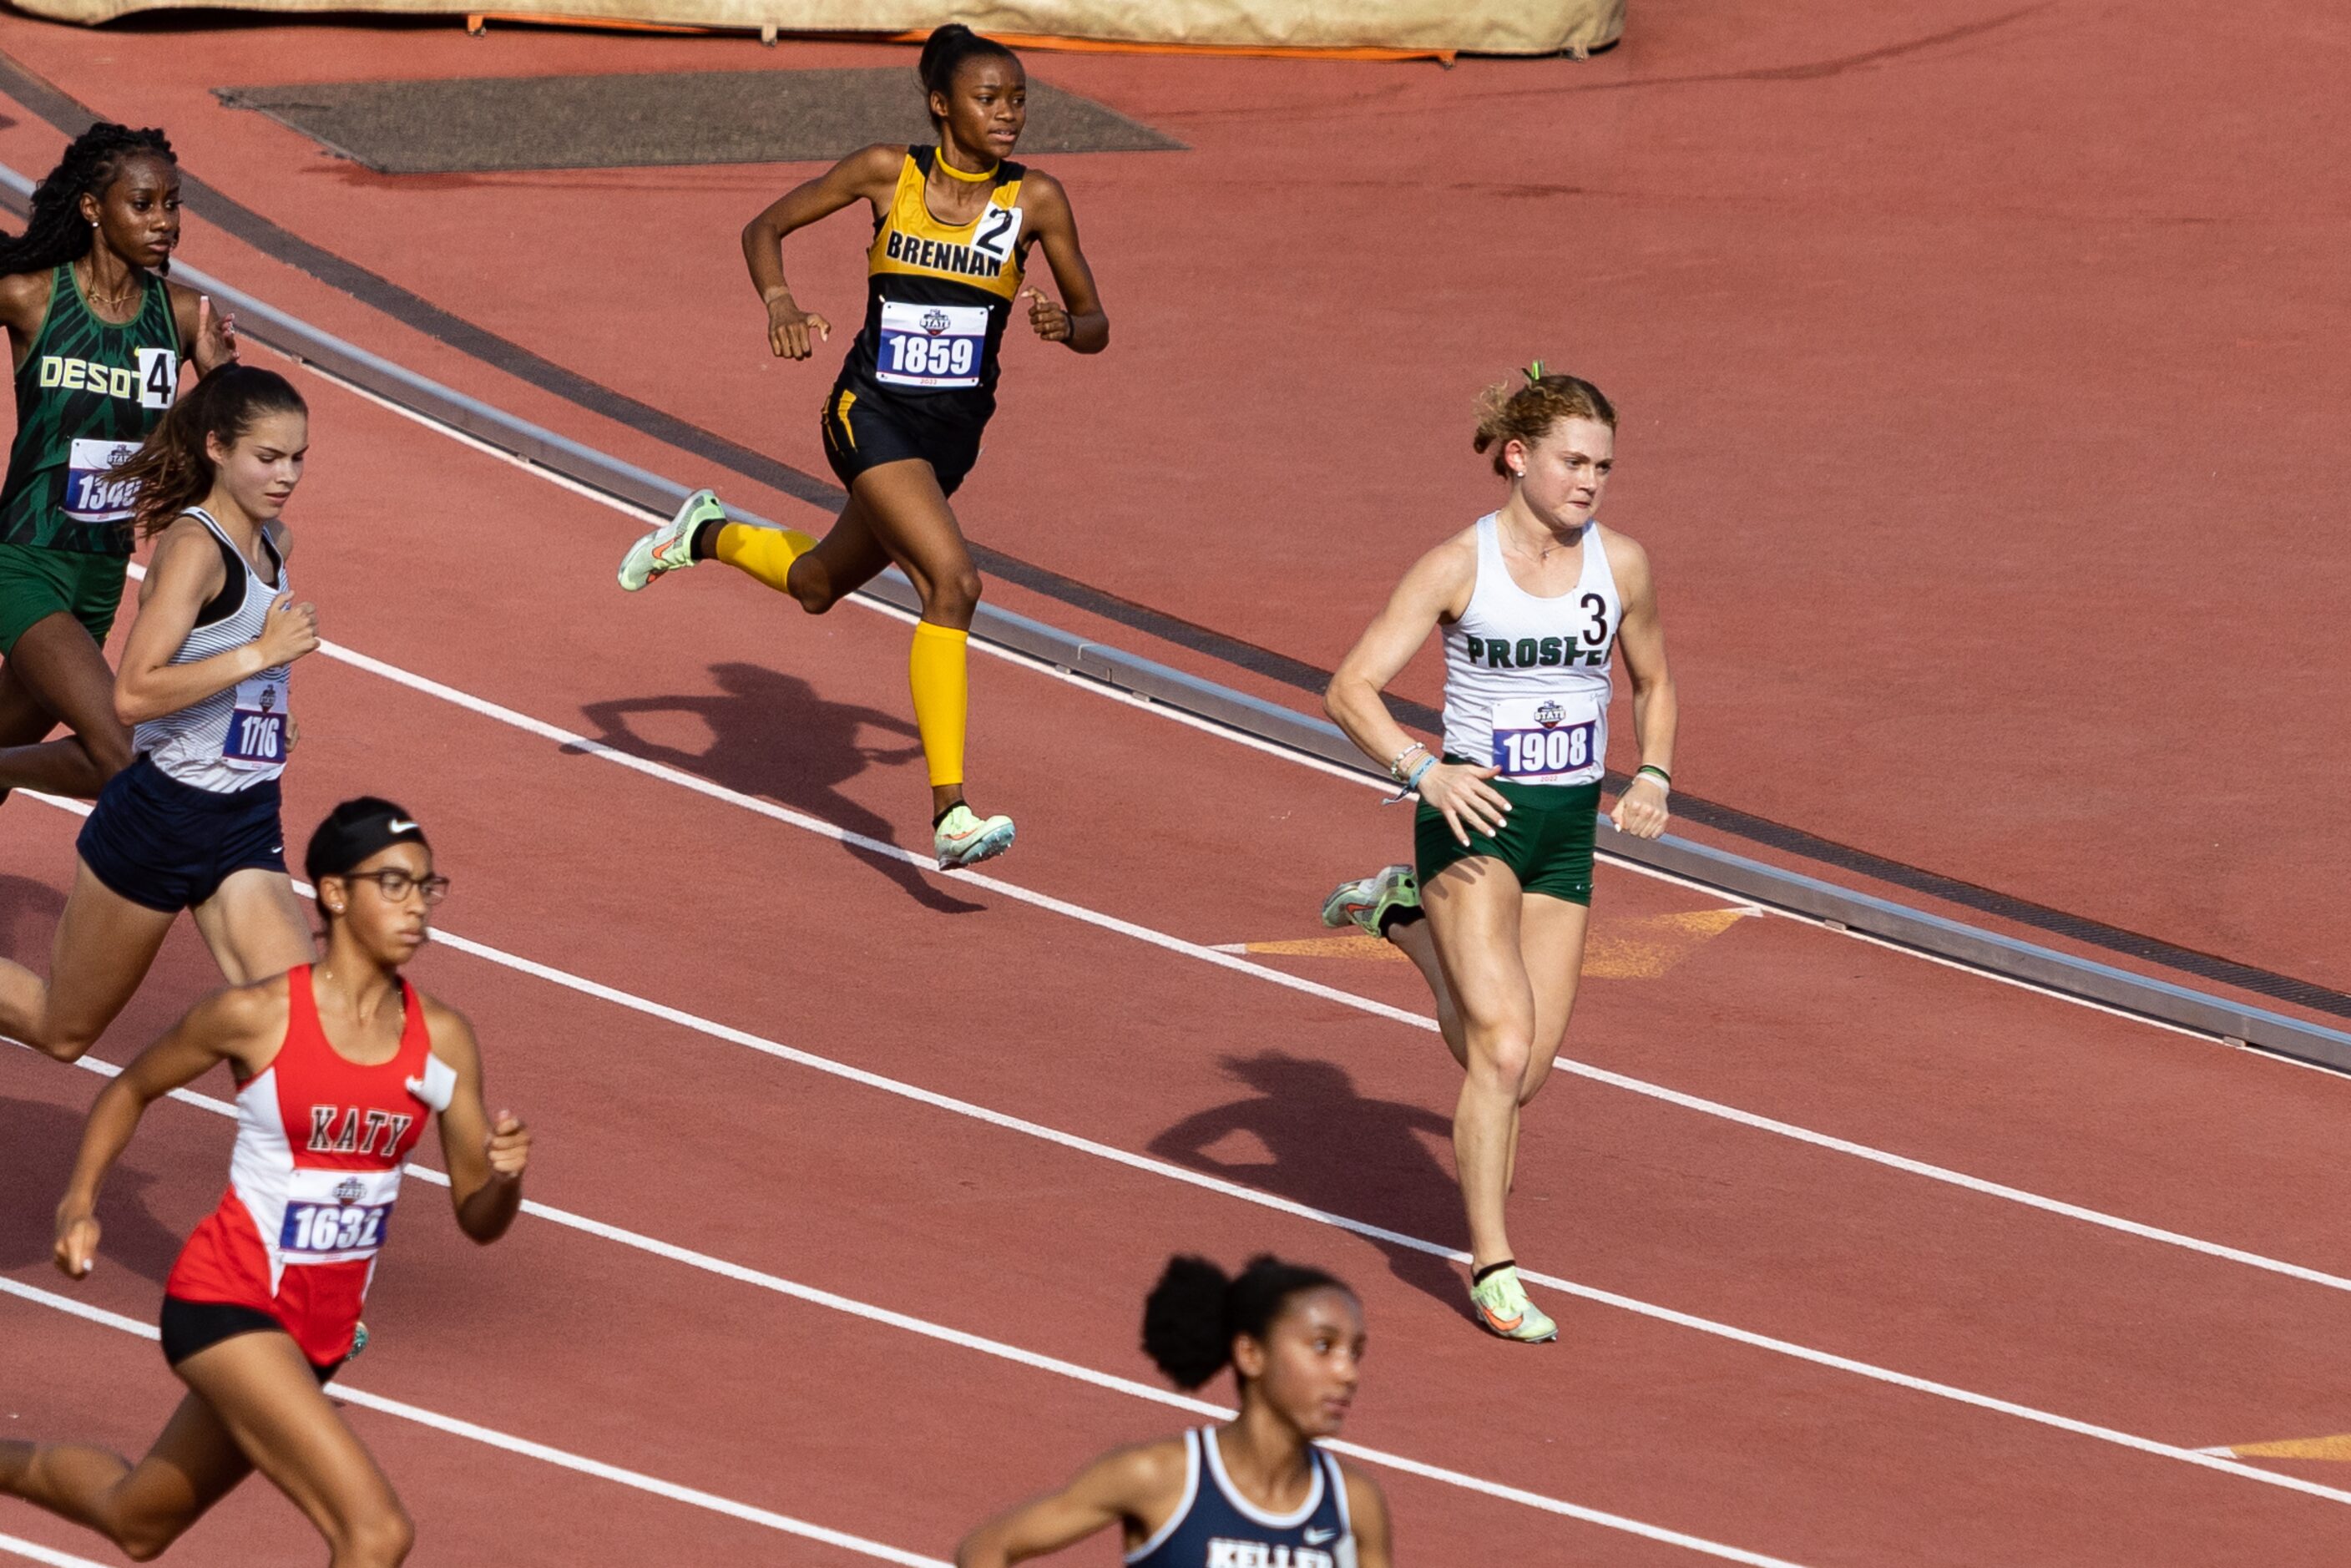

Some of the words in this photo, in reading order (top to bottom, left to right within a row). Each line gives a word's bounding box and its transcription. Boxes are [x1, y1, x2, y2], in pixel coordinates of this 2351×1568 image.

[887, 230, 1002, 277] BRENNAN
[976, 209, 1013, 255] 2
[889, 335, 973, 375] 1859
[40, 356, 144, 402] DESOT
[147, 353, 171, 404] 4
[1580, 593, 1607, 645] 3
[240, 716, 280, 758] 1716
[1503, 727, 1587, 772] 1908
[307, 1105, 412, 1157] KATY
[296, 1205, 384, 1250] 1632
